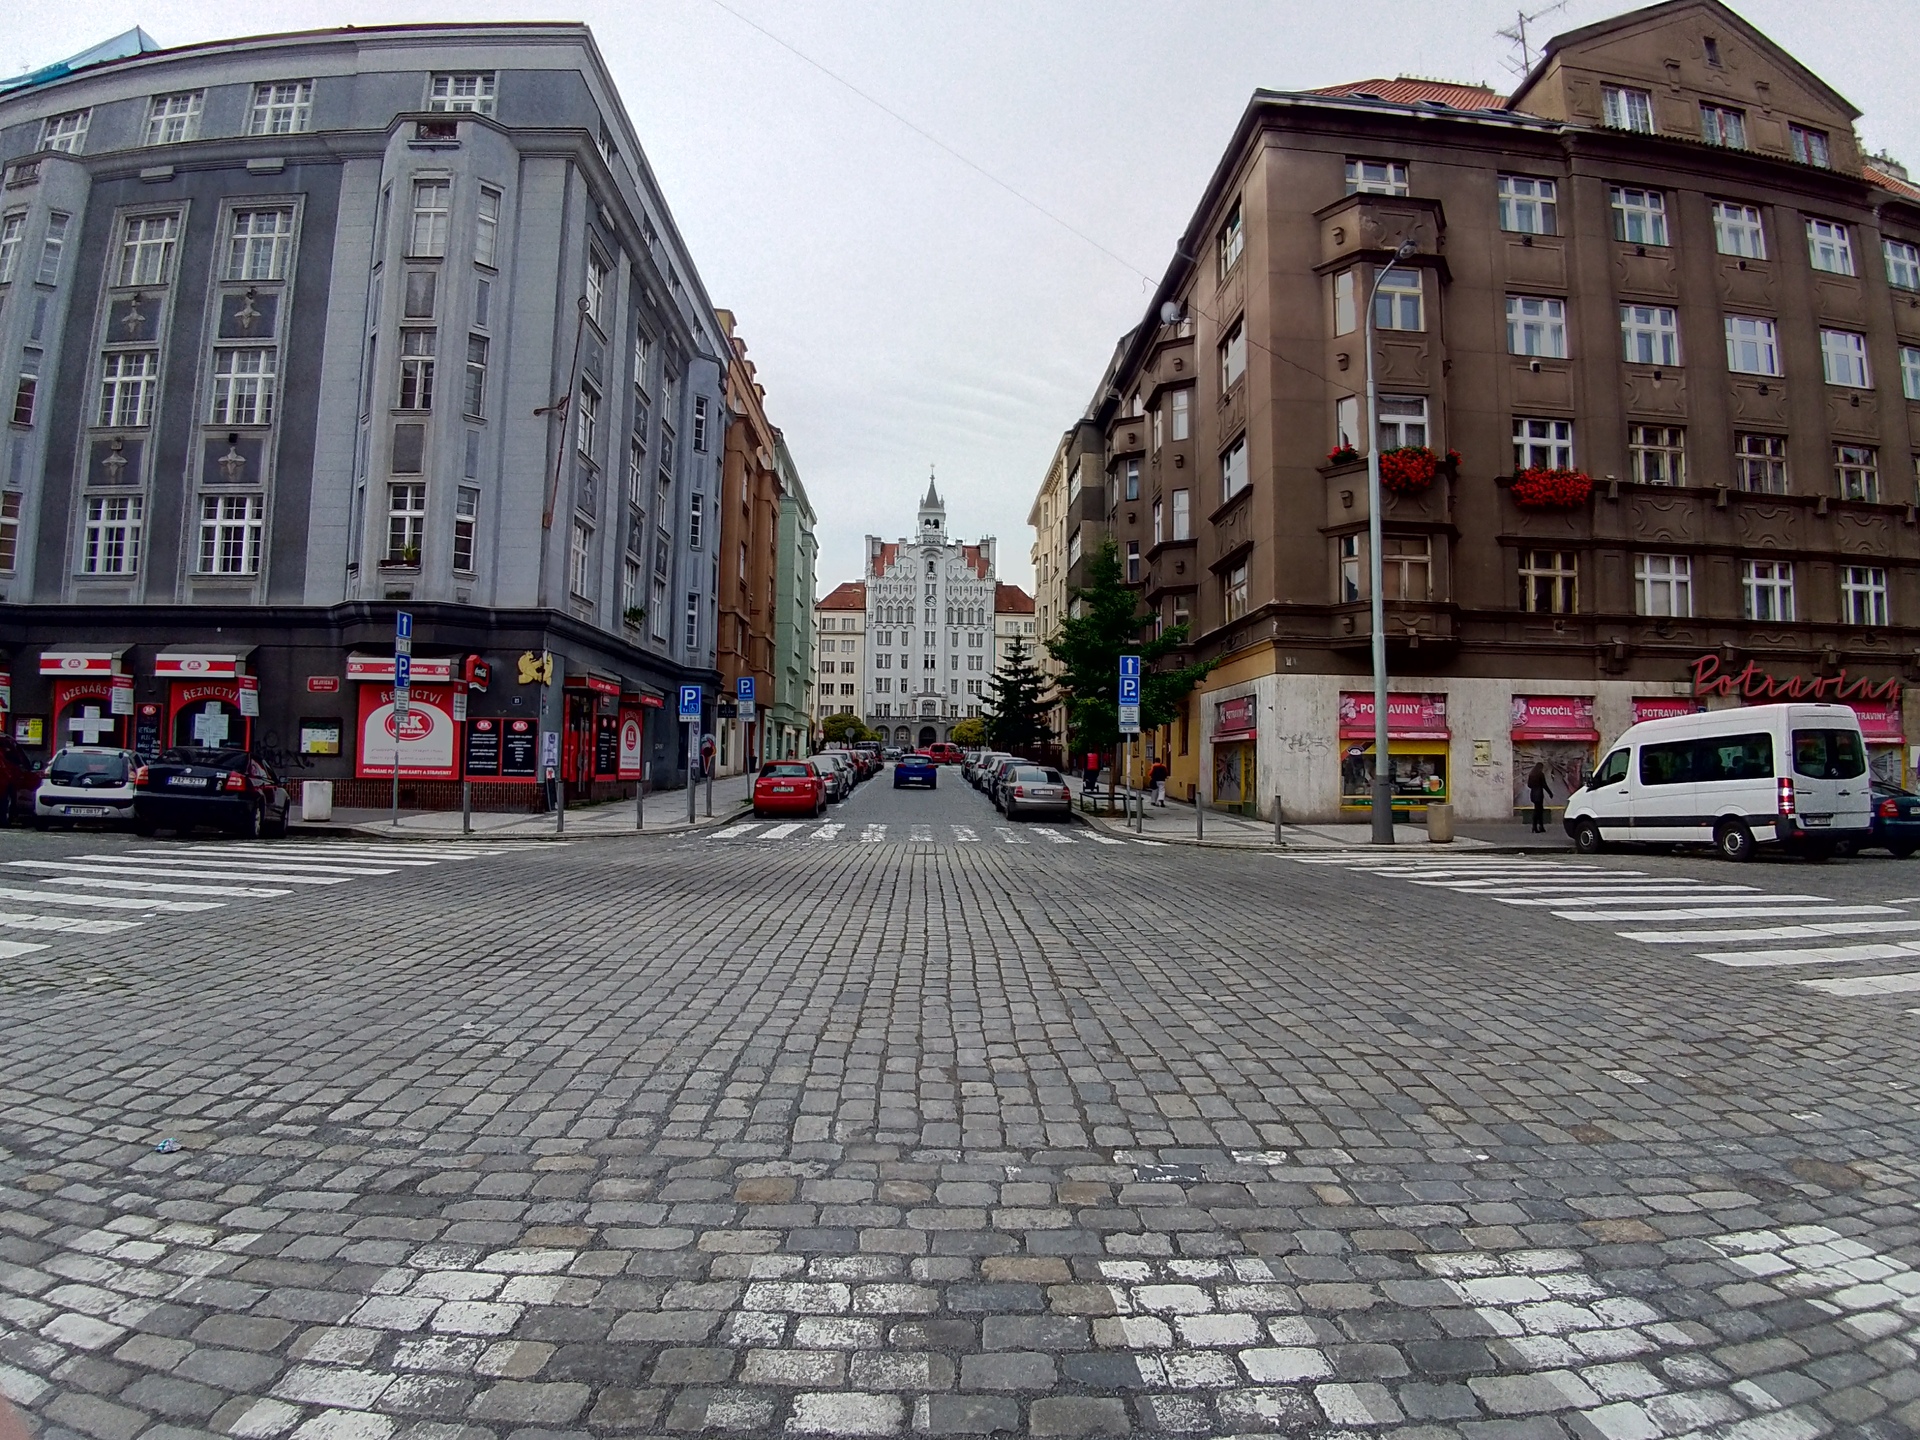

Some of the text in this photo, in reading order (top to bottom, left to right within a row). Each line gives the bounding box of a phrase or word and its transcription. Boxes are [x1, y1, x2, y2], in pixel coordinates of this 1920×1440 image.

[741, 680, 750, 693] P
[1691, 655, 1900, 704] Potraviny
[62, 682, 112, 701] UZENÁŘST
[183, 686, 240, 701] ŘEZNICTVÍ
[1124, 680, 1135, 696] P
[380, 689, 443, 704] ŘEICTVÍ
[684, 689, 696, 706] P
[1360, 703, 1420, 714] POAVINY
[1529, 705, 1572, 716] VYSKOČIL
[1642, 708, 1688, 717] POTRAVINY
[1857, 711, 1886, 721] TRAVINY
